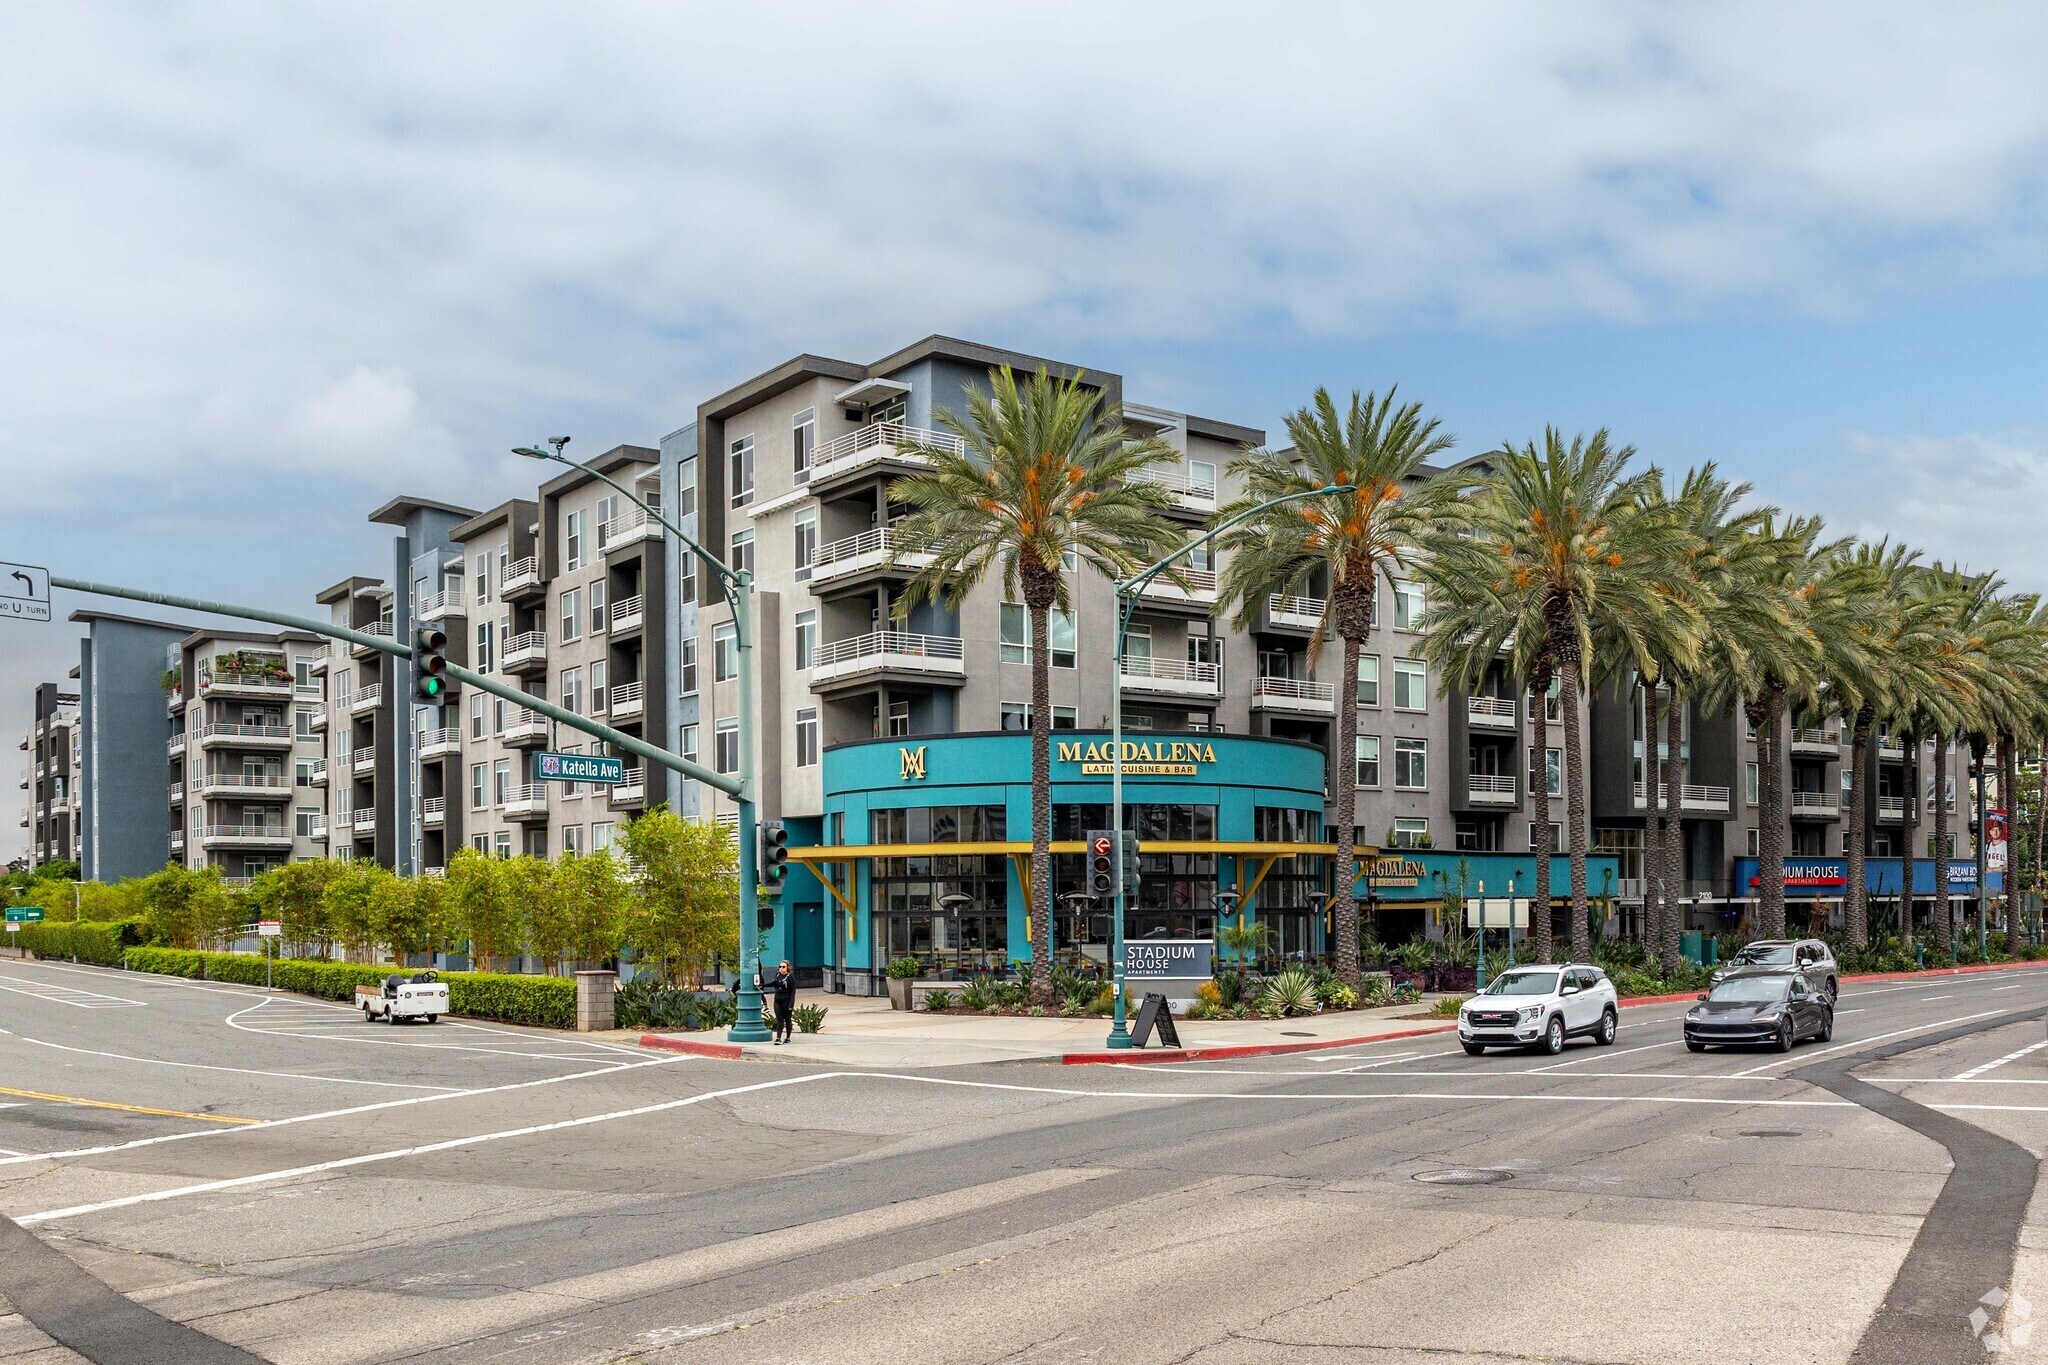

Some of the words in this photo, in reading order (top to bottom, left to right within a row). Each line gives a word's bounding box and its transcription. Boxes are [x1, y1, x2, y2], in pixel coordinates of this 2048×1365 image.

[13, 603, 21, 613] U
[26, 606, 47, 614] TURN
[1058, 741, 1218, 763] MAGDALENA
[562, 760, 598, 777] Katella
[601, 763, 619, 778] Ave
[1121, 764, 1161, 773] CUISINE
[1164, 766, 1171, 774] &
[1174, 766, 1194, 774] BAR
[1806, 866, 1839, 878] HOUSE
[1128, 947, 1195, 959] STADIUM
[1127, 959, 1169, 969] HOUSE
